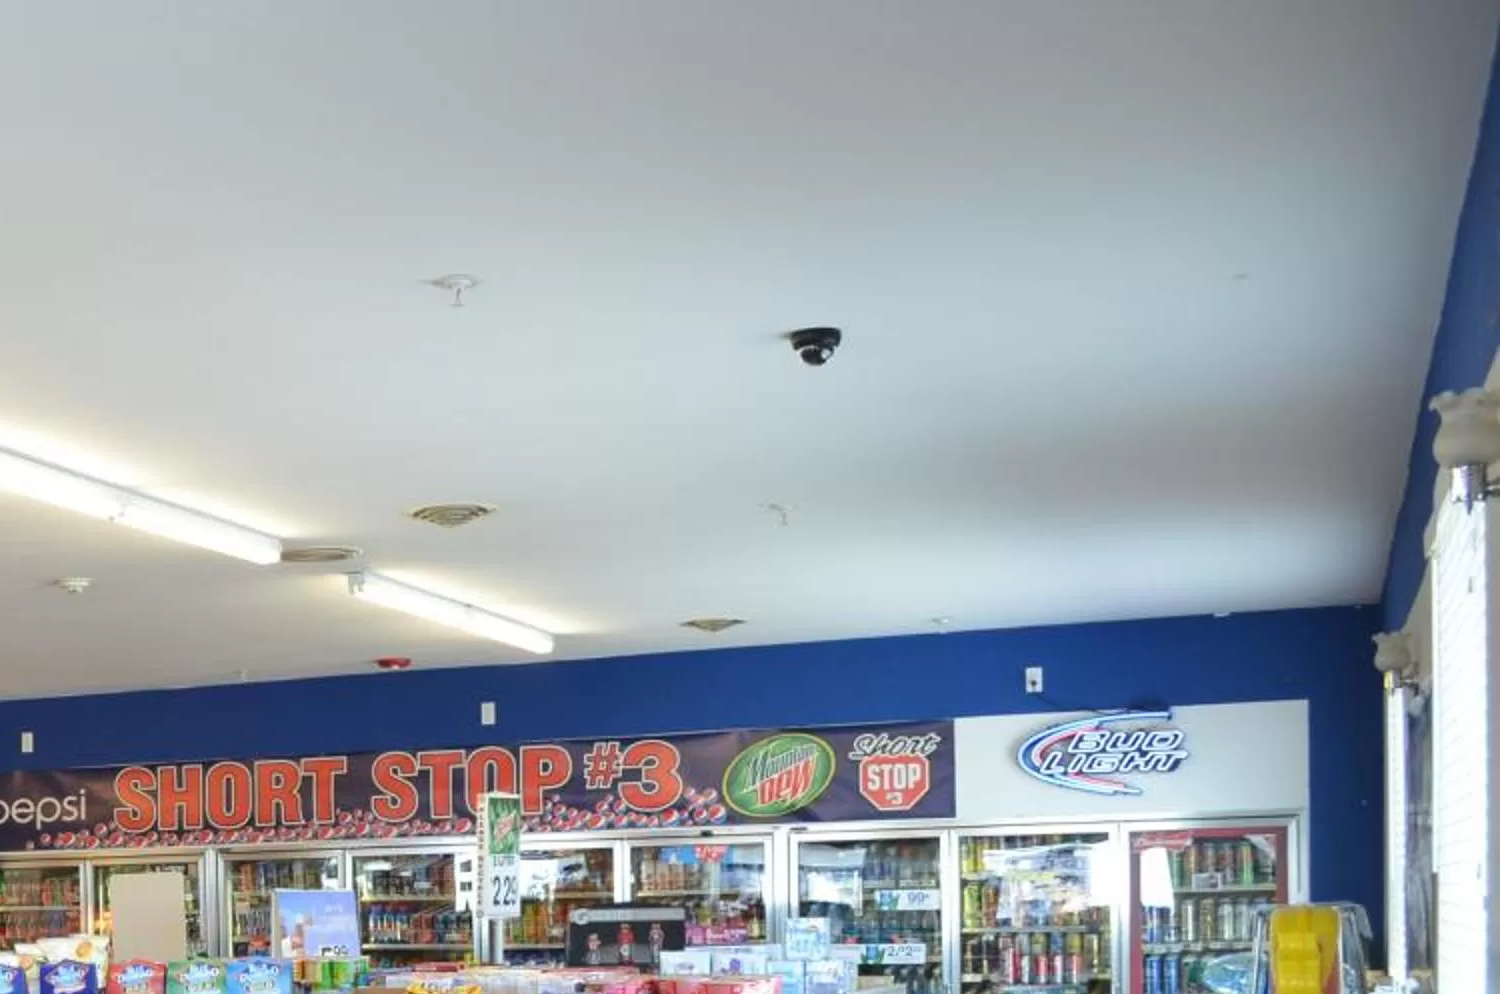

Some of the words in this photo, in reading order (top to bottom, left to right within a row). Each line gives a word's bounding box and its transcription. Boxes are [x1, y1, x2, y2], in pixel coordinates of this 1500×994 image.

[848, 732, 941, 760] Short
[1069, 730, 1187, 753] BUD
[583, 739, 685, 812] #3
[1039, 749, 1188, 774] LIGHT
[114, 755, 348, 834] SHORT
[371, 744, 572, 823] STOP
[867, 763, 922, 791] STOP
